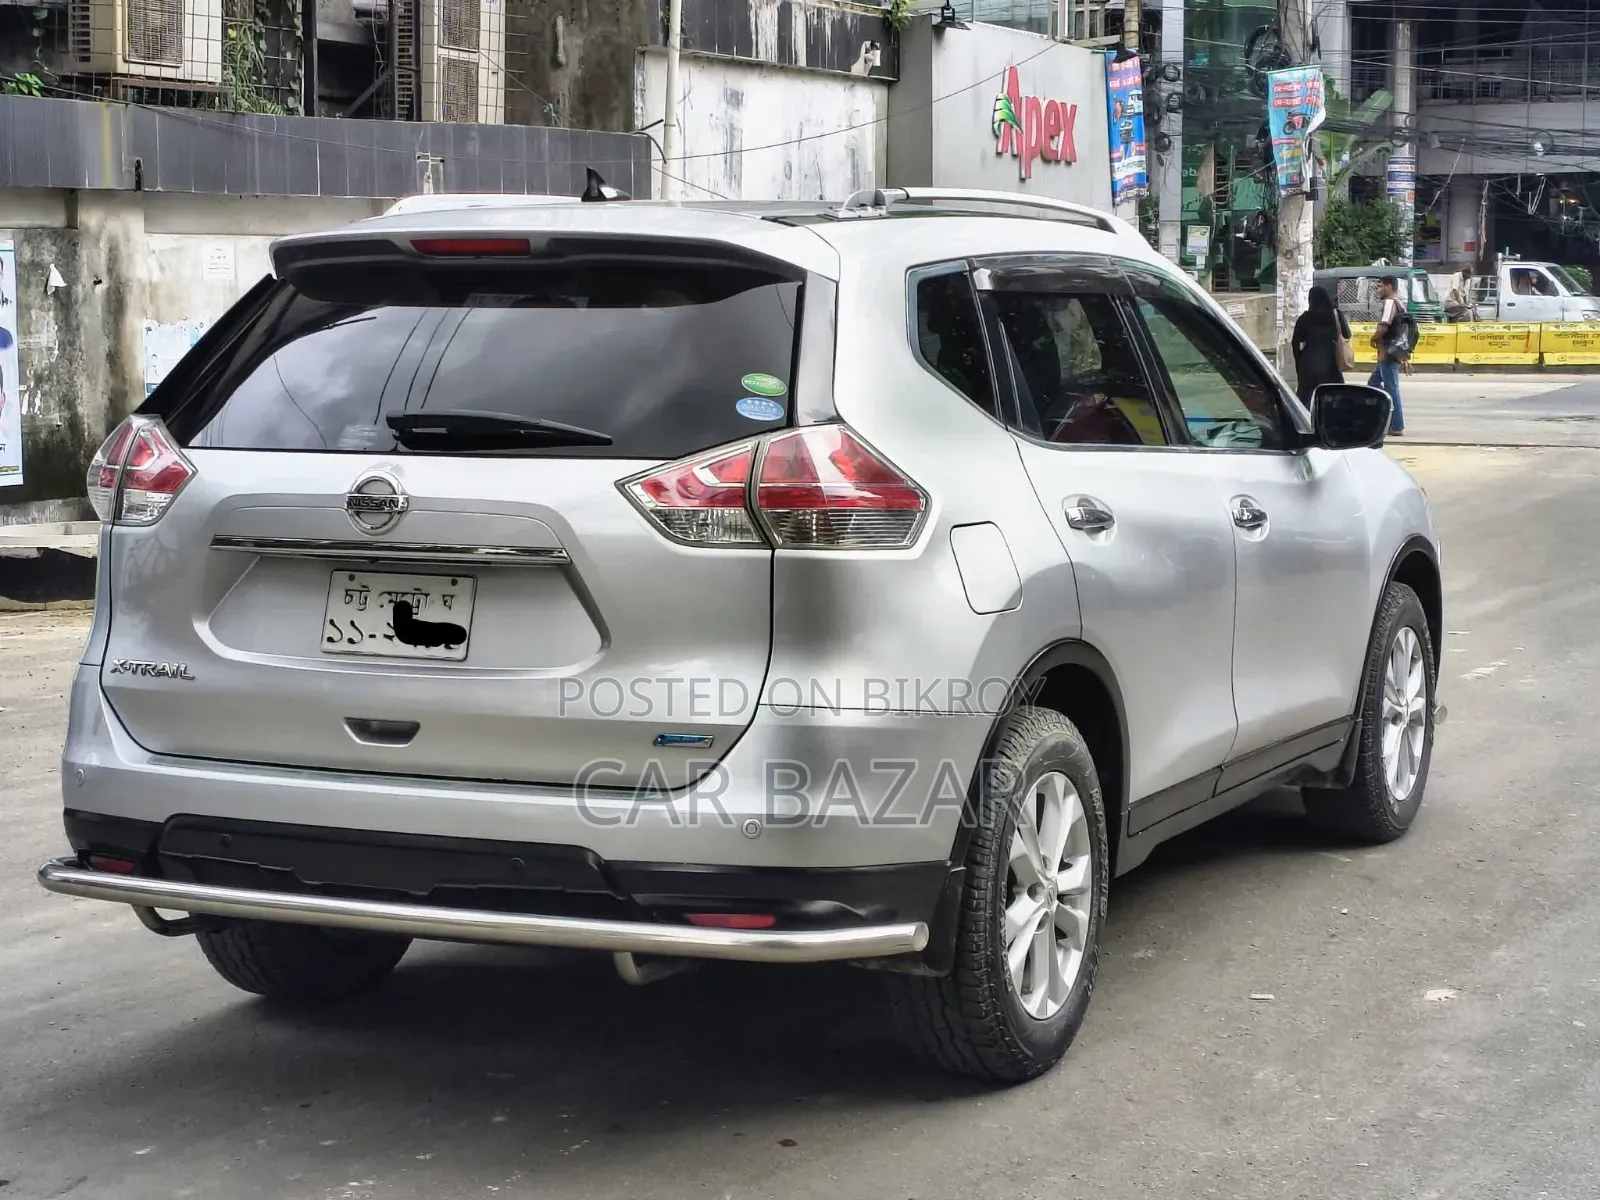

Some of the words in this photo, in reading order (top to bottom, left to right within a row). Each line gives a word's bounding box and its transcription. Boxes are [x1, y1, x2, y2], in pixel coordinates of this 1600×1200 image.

[996, 65, 1077, 181] Apex
[348, 497, 399, 508] NISSAN
[110, 658, 196, 681] X-TRAIL
